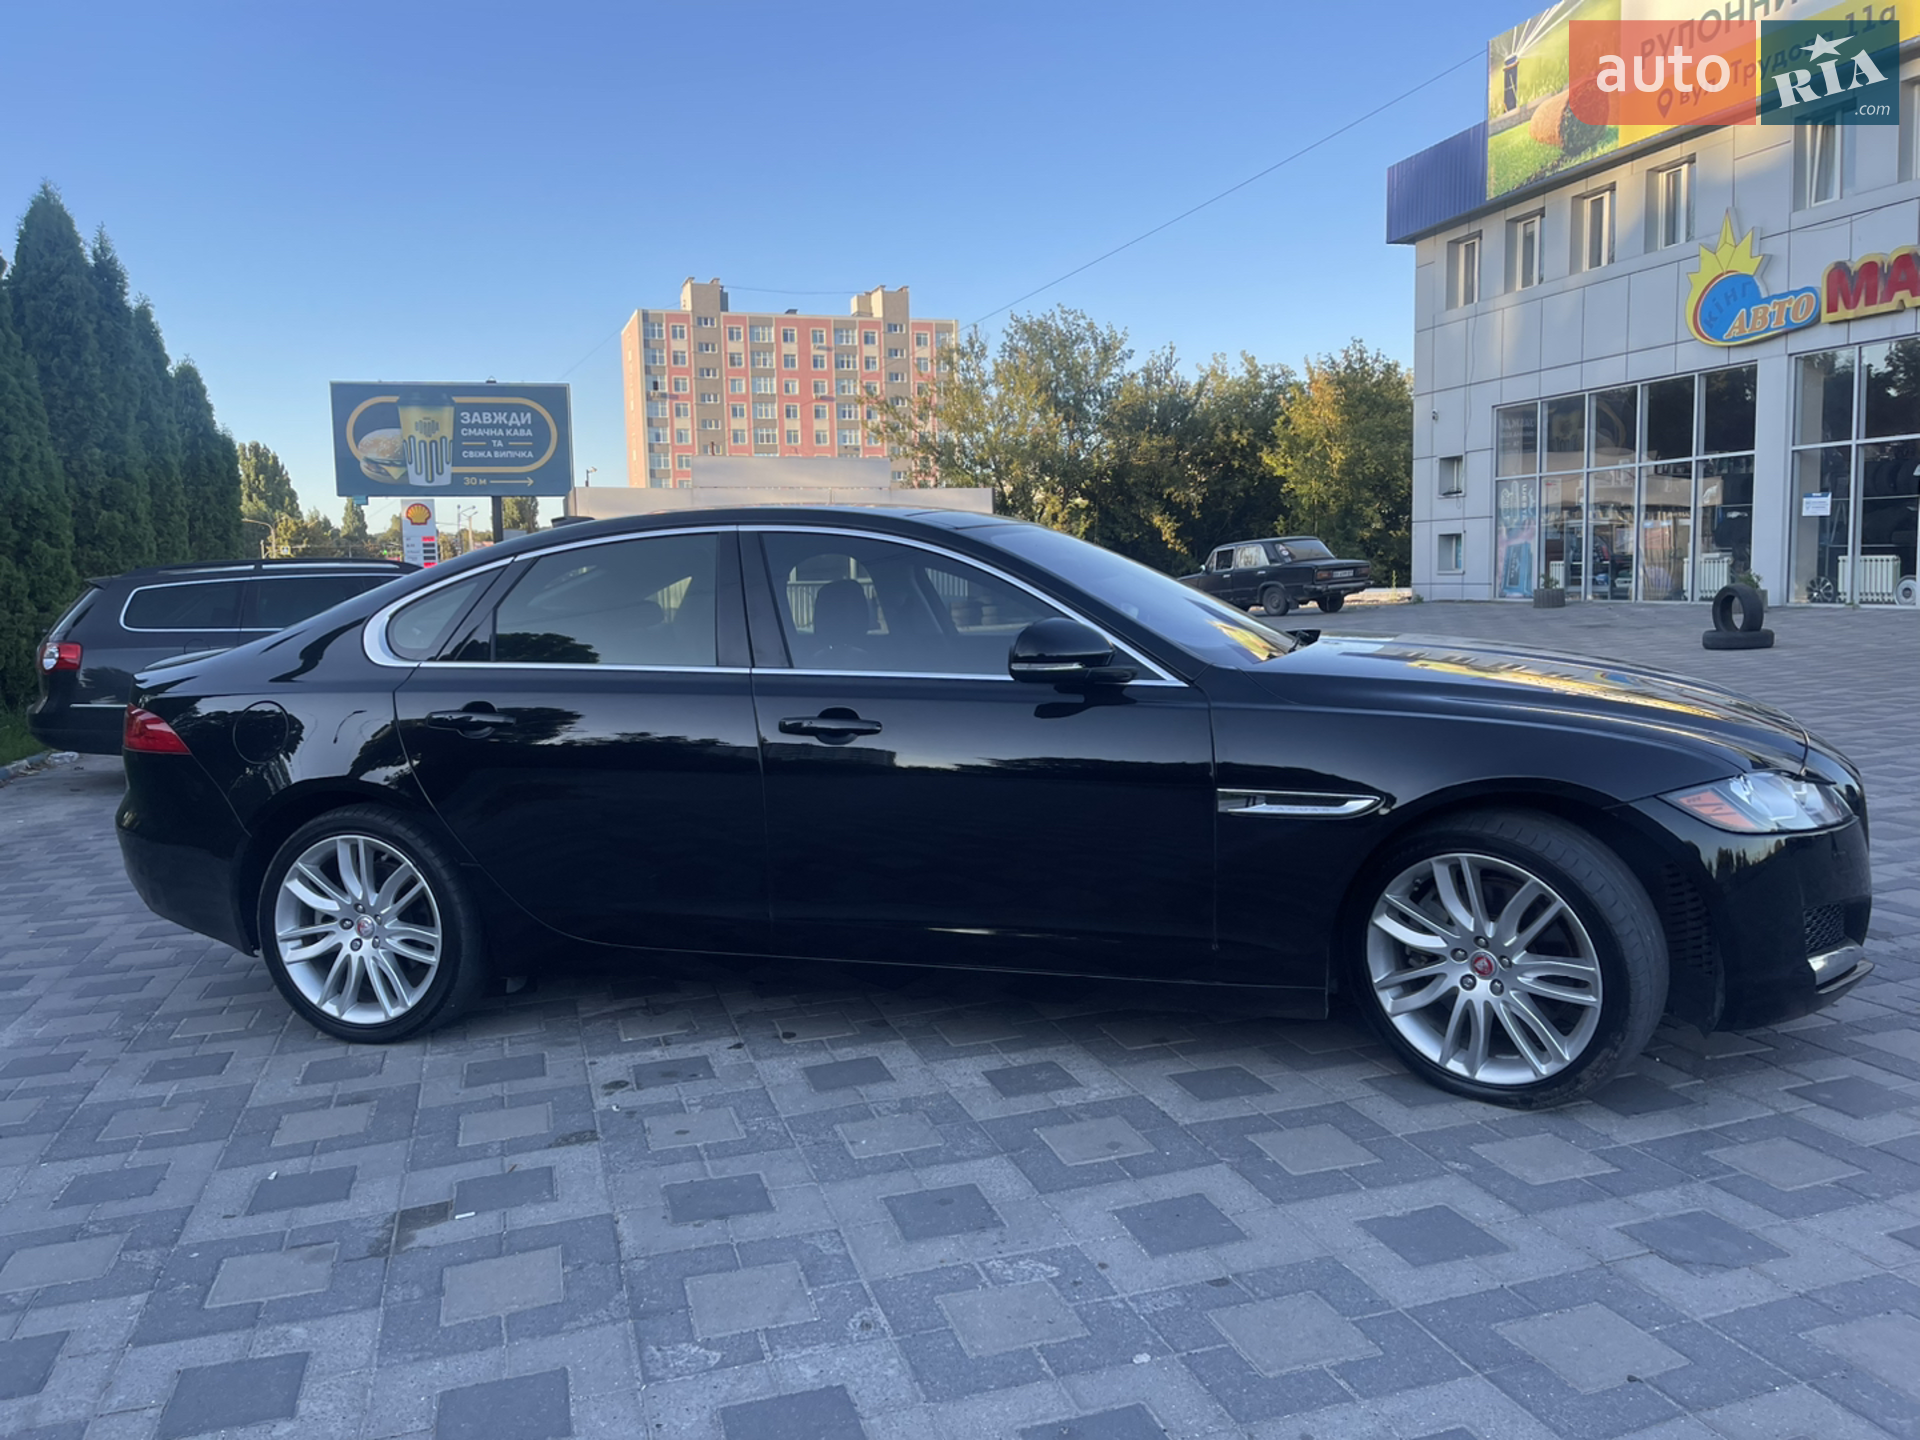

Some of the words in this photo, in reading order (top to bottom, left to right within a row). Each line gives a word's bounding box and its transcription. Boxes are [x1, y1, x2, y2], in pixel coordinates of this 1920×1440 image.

[1723, 292, 1817, 340] АВТО
[460, 411, 532, 427] ЗАВЖДИ
[460, 427, 505, 437] СМАЧНА
[505, 428, 533, 437] КАВА
[491, 439, 504, 448] ТА
[461, 450, 493, 459] СВІЖА
[493, 450, 534, 459] ВИПІЧКА
[463, 476, 478, 486] 30
